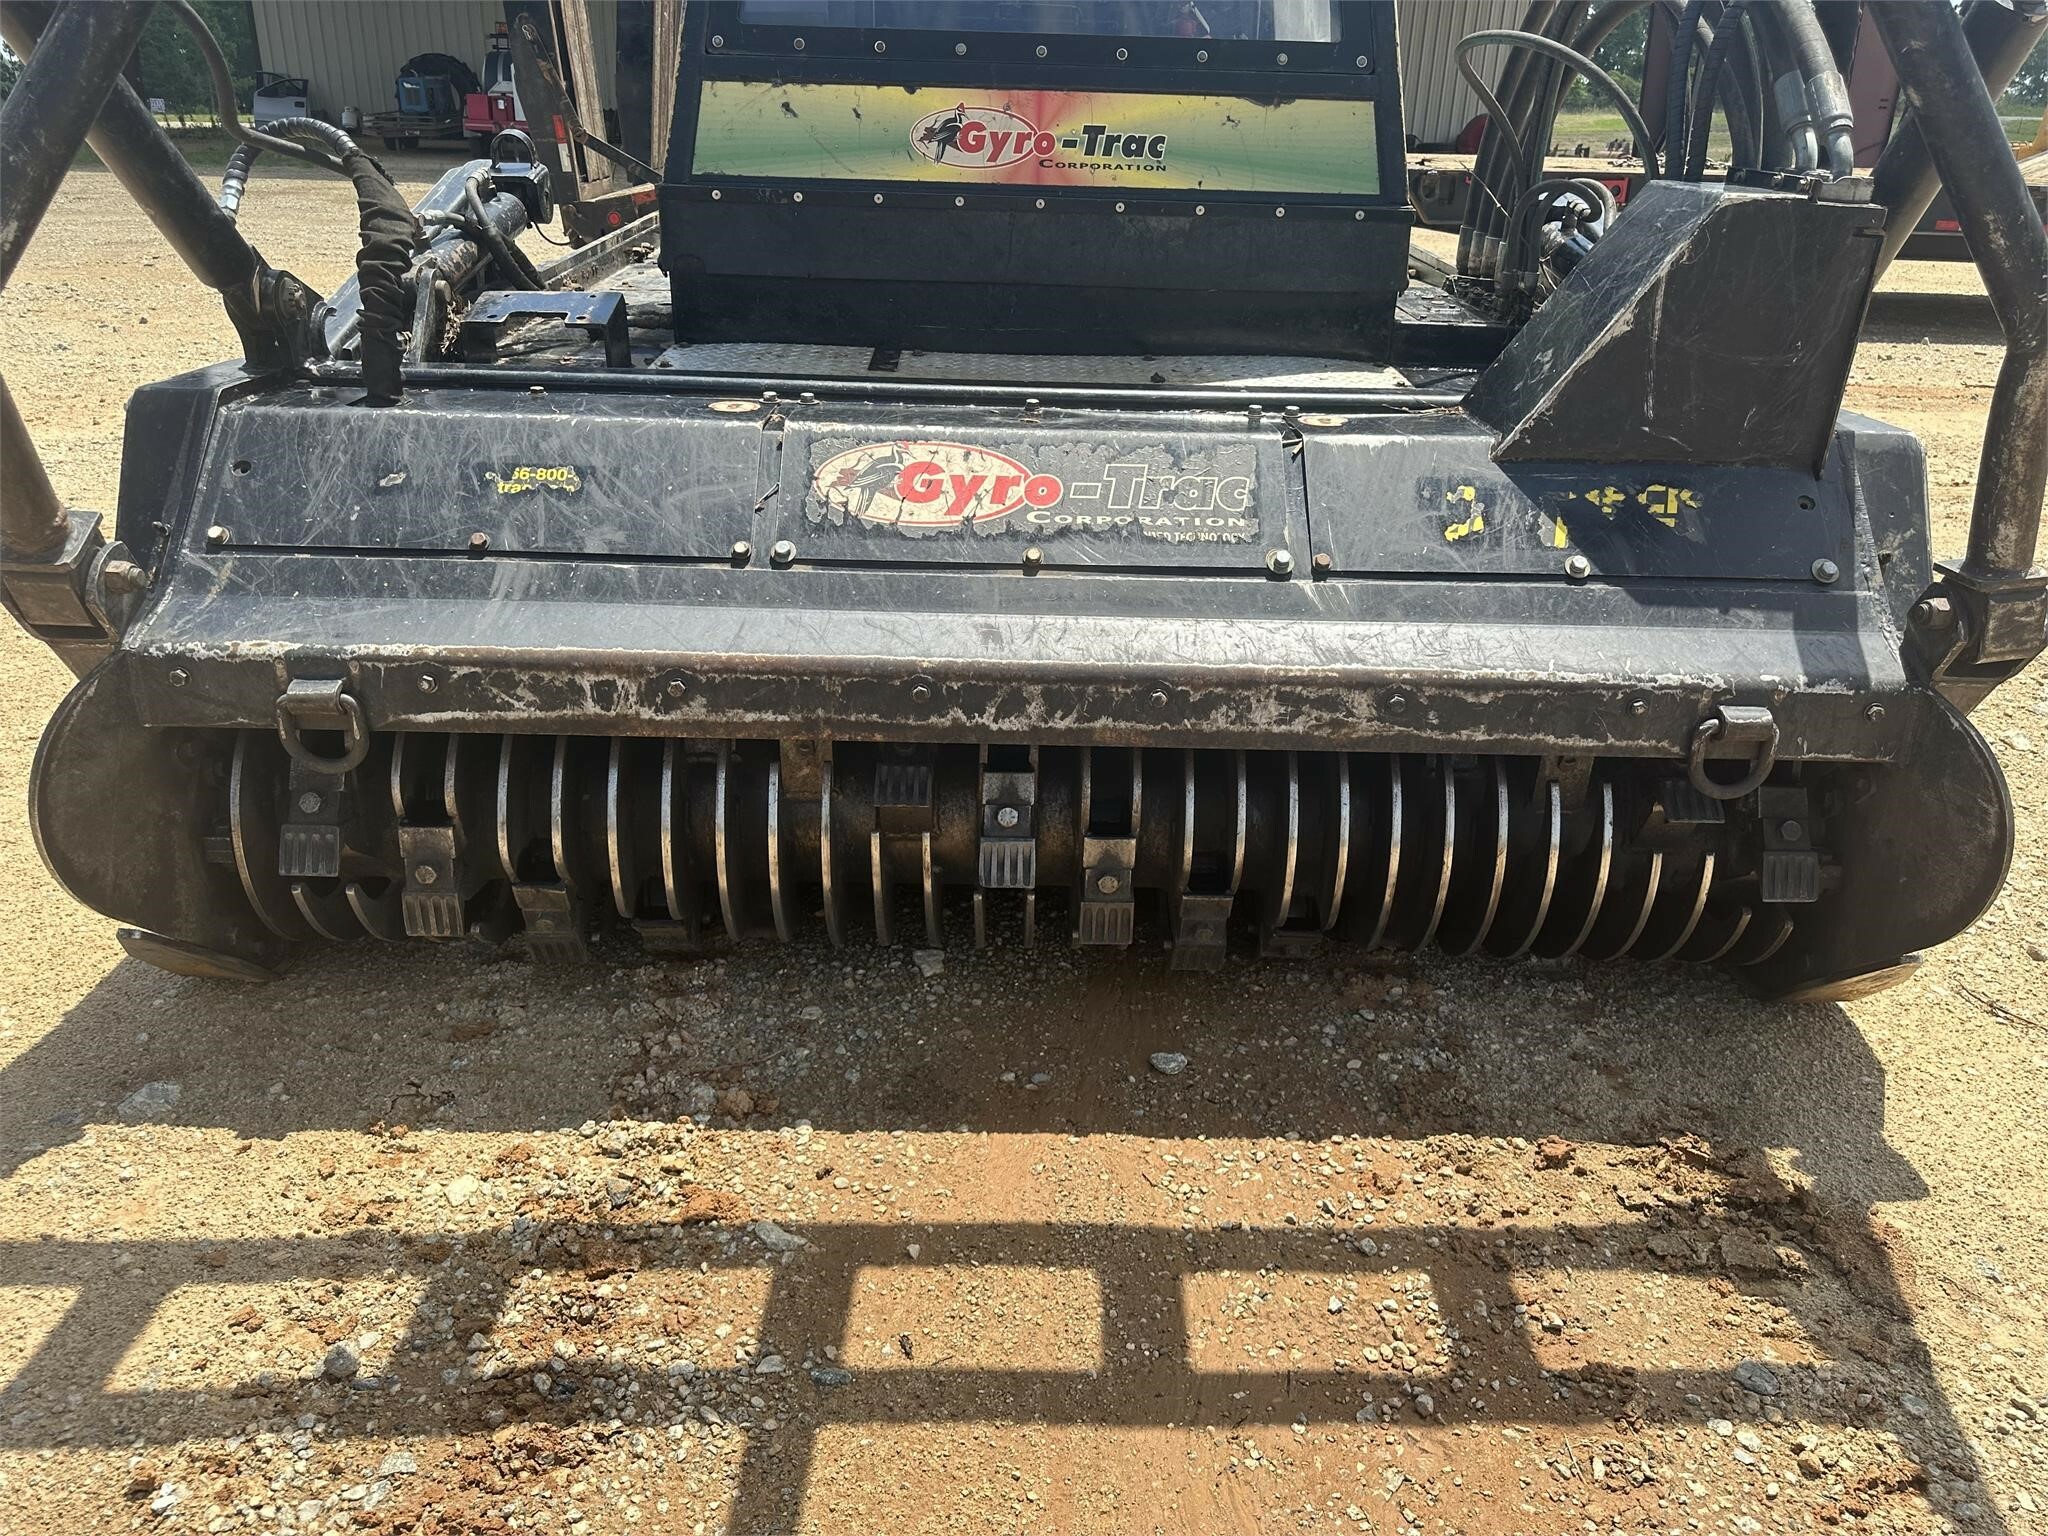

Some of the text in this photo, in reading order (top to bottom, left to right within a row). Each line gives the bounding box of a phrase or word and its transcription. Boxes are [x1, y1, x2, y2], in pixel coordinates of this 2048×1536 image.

[957, 120, 1167, 164] Gyro-Trac
[1038, 158, 1168, 173] CORPORATION
[896, 460, 1252, 517] Gyro-Trac
[1026, 510, 1246, 528] CORPORATION
